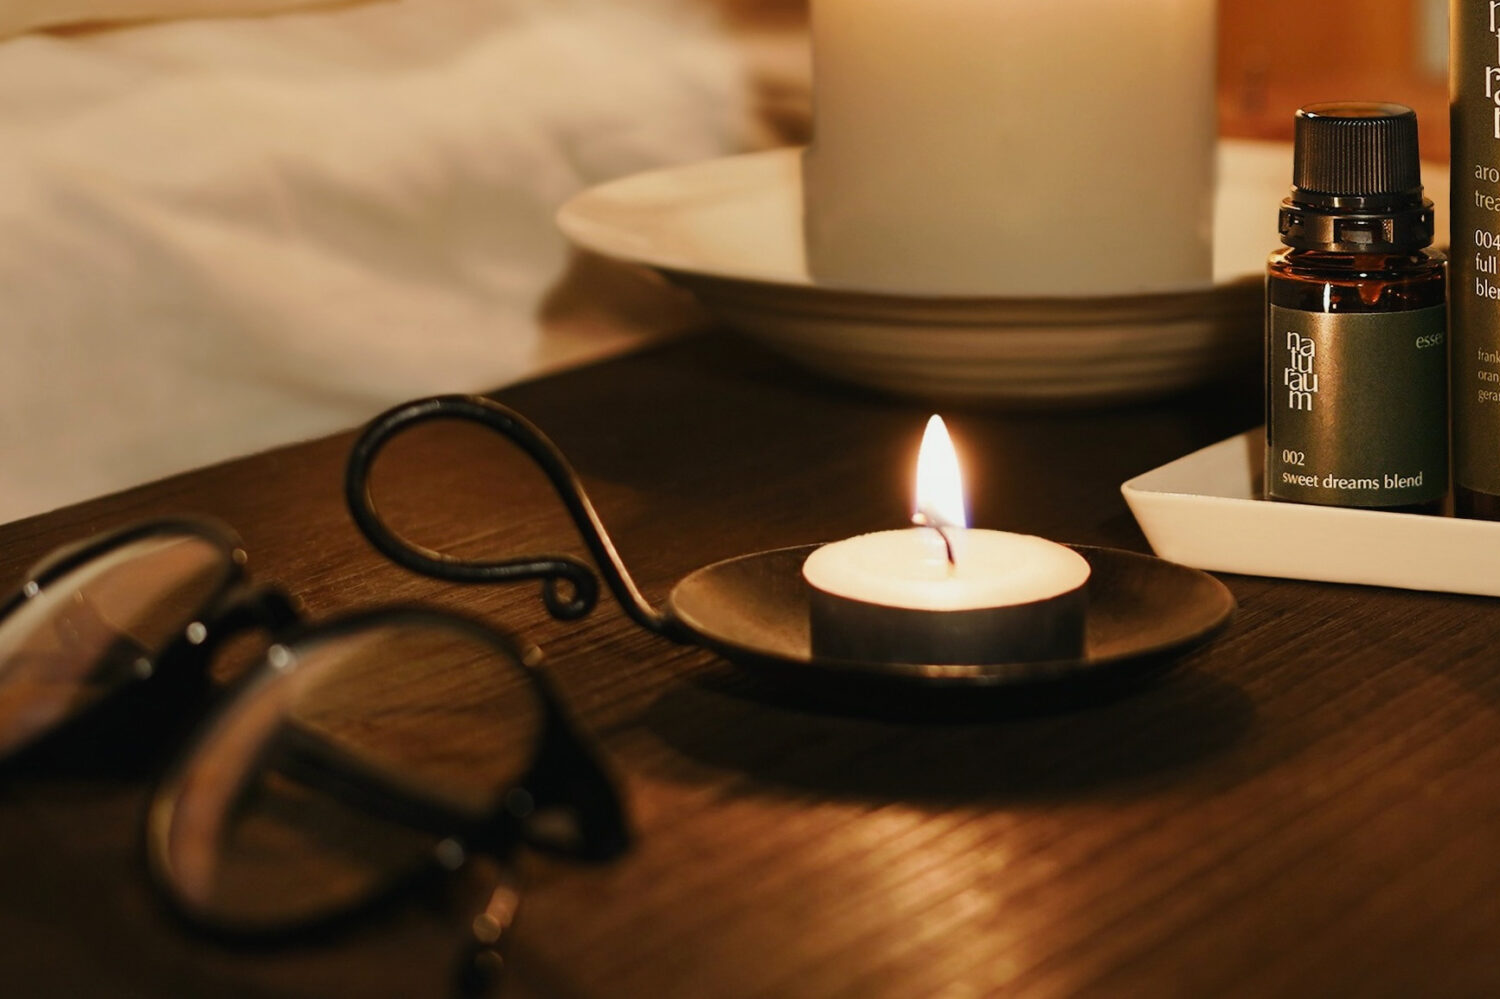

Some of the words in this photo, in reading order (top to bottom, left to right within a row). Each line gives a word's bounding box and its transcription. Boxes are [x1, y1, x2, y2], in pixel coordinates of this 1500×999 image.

[1475, 253, 1498, 275] full
[1282, 449, 1305, 466] 002
[1282, 472, 1319, 488] sweet
[1322, 473, 1380, 490] dreams
[1384, 471, 1423, 489] blend
